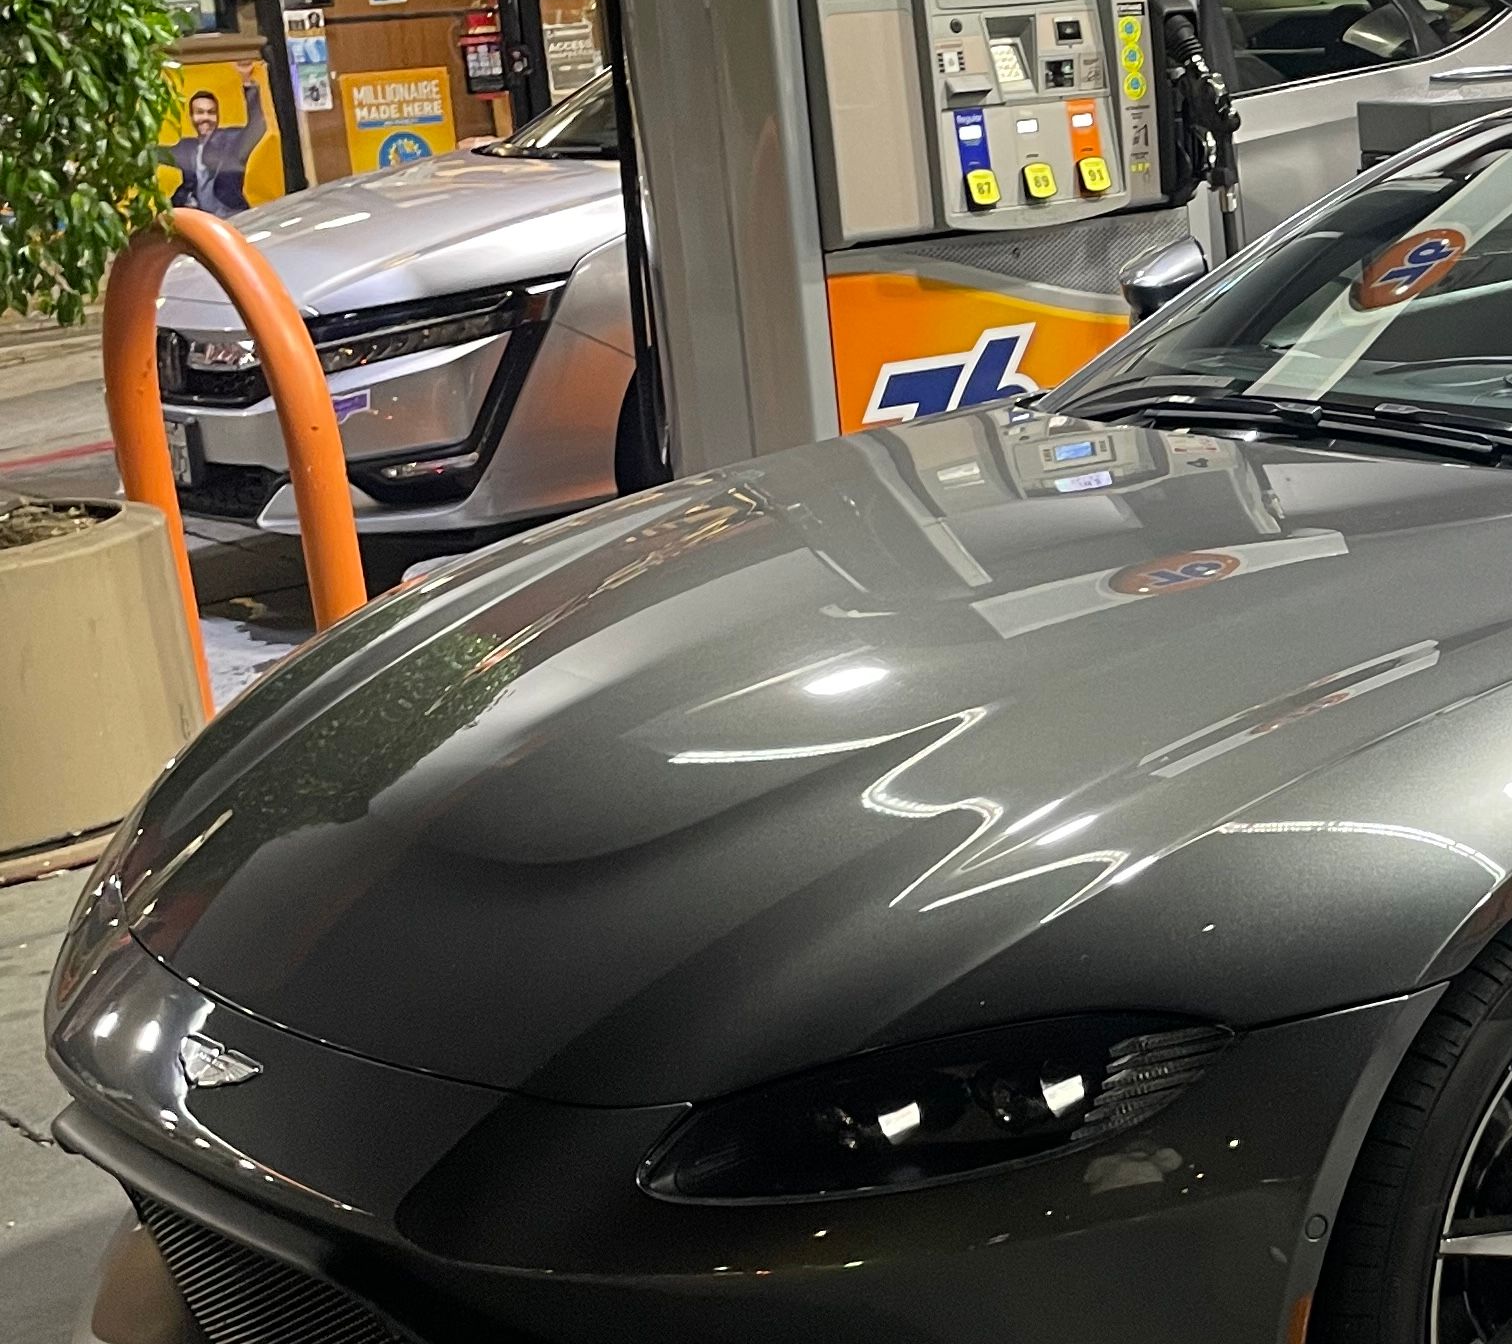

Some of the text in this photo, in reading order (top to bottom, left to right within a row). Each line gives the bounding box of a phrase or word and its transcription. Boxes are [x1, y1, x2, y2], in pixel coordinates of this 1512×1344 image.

[352, 80, 441, 105] MILLIONAIRE
[355, 106, 400, 122] MADE
[403, 100, 444, 117] HERE
[1033, 175, 1050, 189] 89
[1088, 168, 1105, 183] 91
[976, 182, 992, 196] 87
